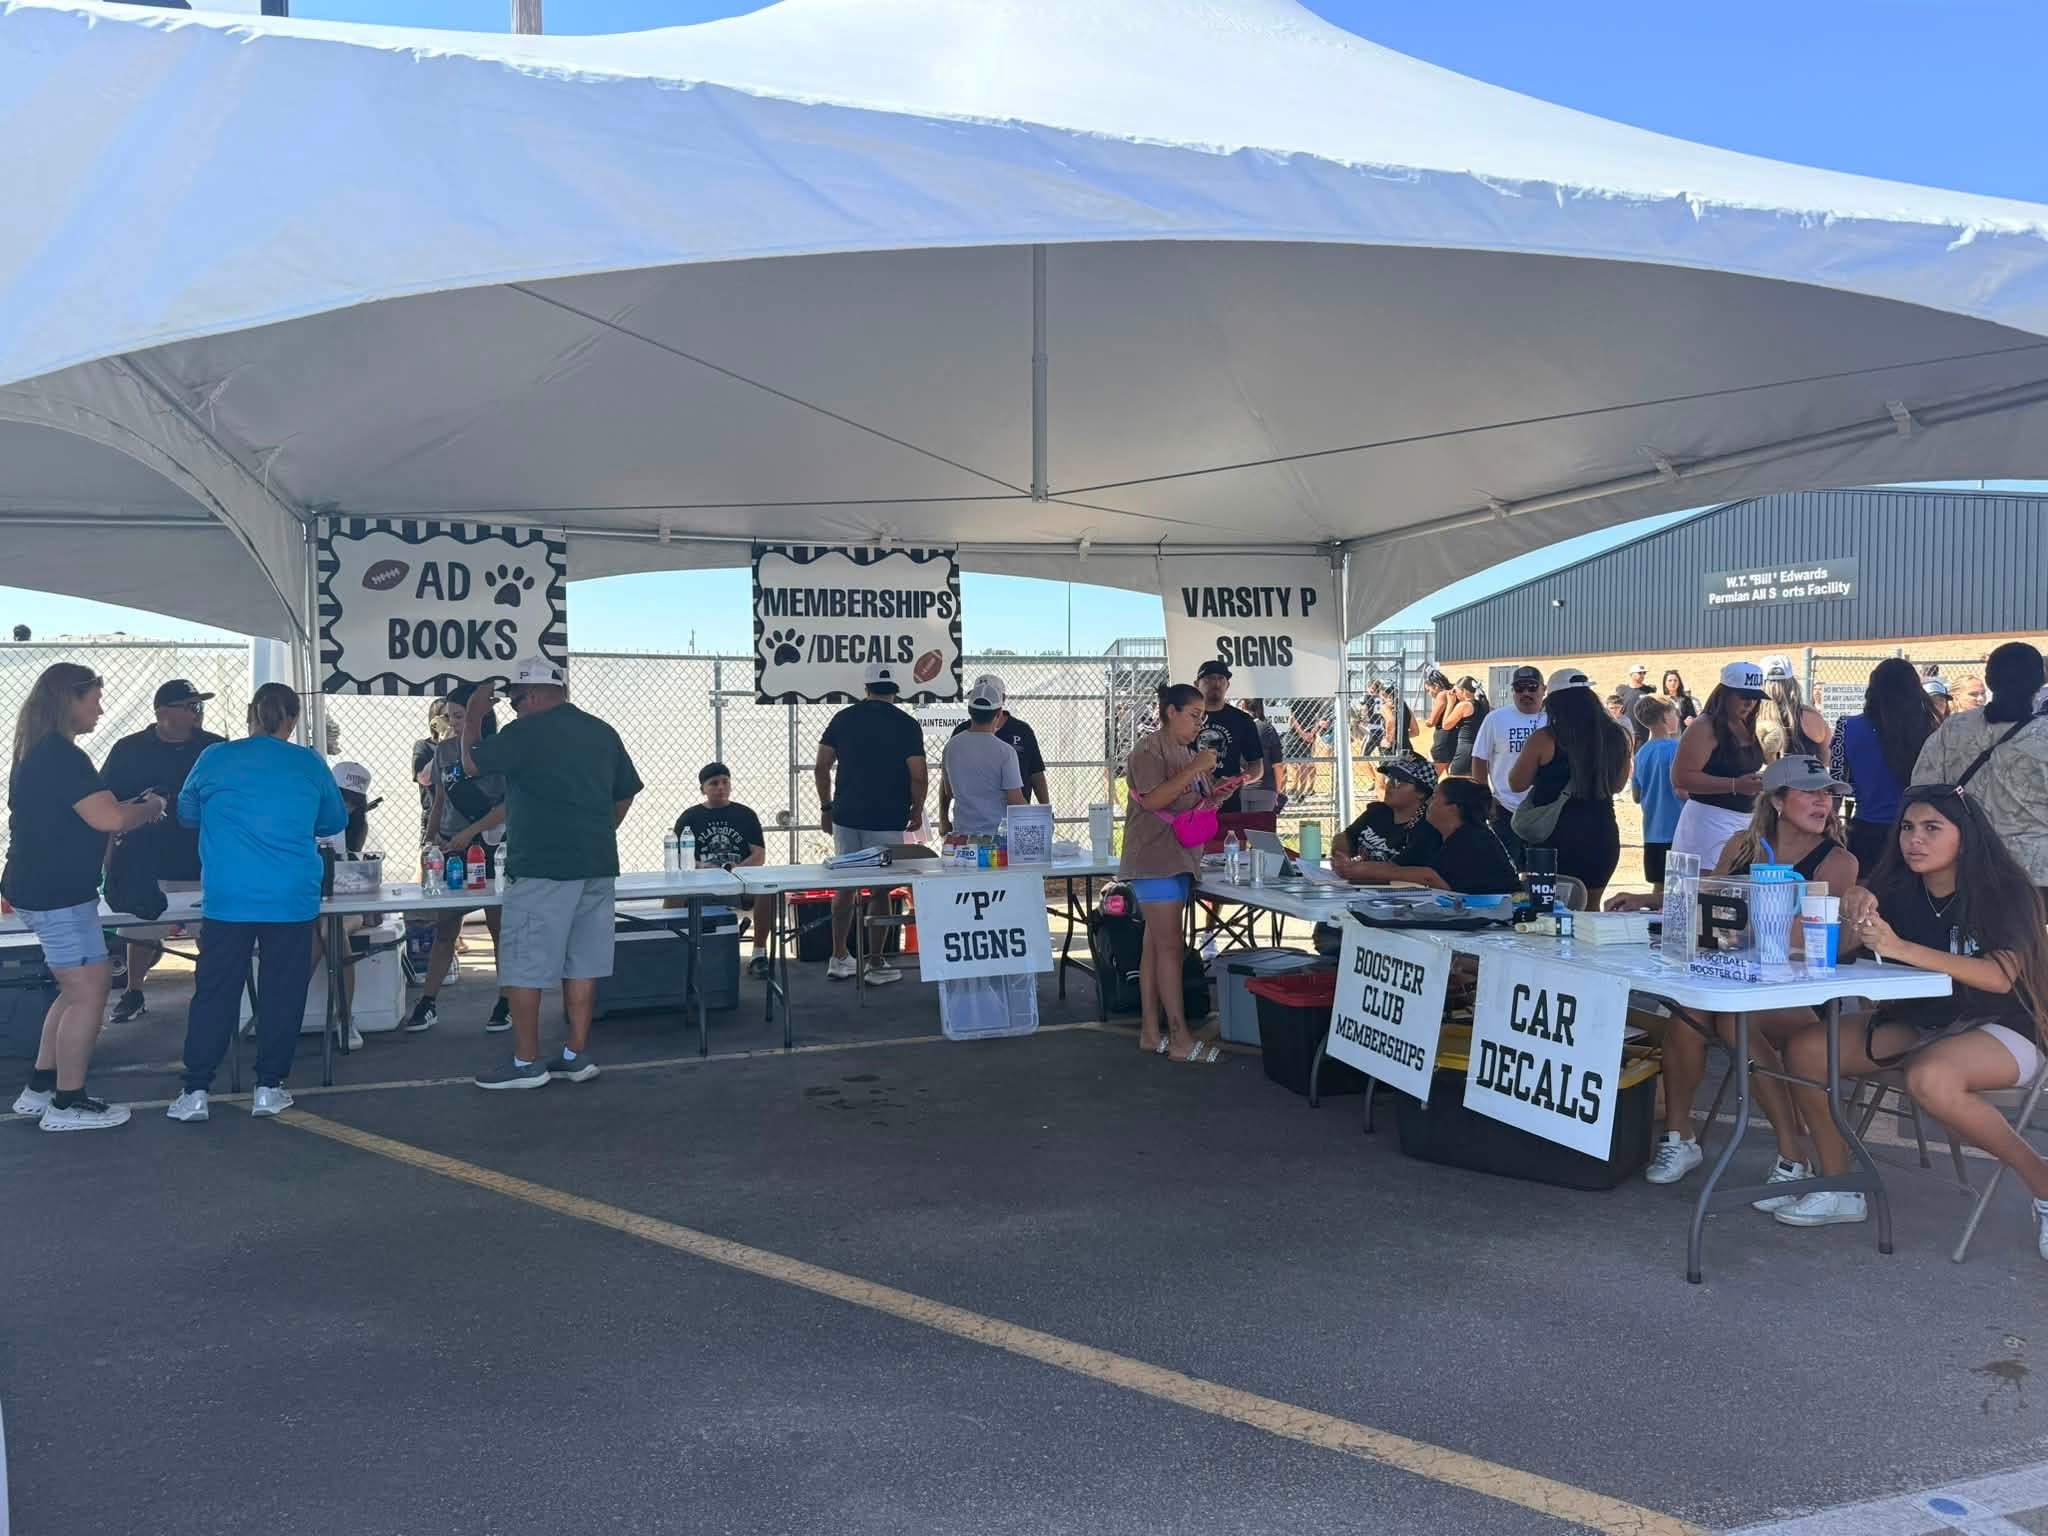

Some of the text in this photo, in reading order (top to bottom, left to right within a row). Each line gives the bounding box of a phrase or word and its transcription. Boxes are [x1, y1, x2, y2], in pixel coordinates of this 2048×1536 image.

[415, 561, 471, 601] AD
[1709, 592, 1750, 605] Permian
[1752, 588, 1766, 601] All
[1807, 581, 1851, 596] Facility
[1726, 575, 1748, 589] W.T.
[1780, 568, 1828, 583] Edwards
[763, 587, 952, 619] MEMBERSHIPS
[1181, 587, 1317, 617] VARSITY P
[388, 618, 517, 660] BOOKS
[807, 634, 914, 664] /DECALS
[1216, 635, 1293, 667] SIGNS
[918, 718, 966, 727] MAINTENANC
[1013, 736, 1021, 745] P
[955, 890, 1006, 920] "P"
[1541, 895, 1553, 905] P
[944, 928, 1027, 962] SIGNS
[1700, 952, 1747, 969] FOOTBALL
[1353, 946, 1426, 996] BOOSTER
[1690, 963, 1731, 979] BOOSTER
[1362, 985, 1405, 1025] CLUB
[1510, 983, 1577, 1047] CAR
[1335, 1014, 1426, 1072] MEMBERSHIPS
[1476, 1039, 1603, 1125] DECALS
